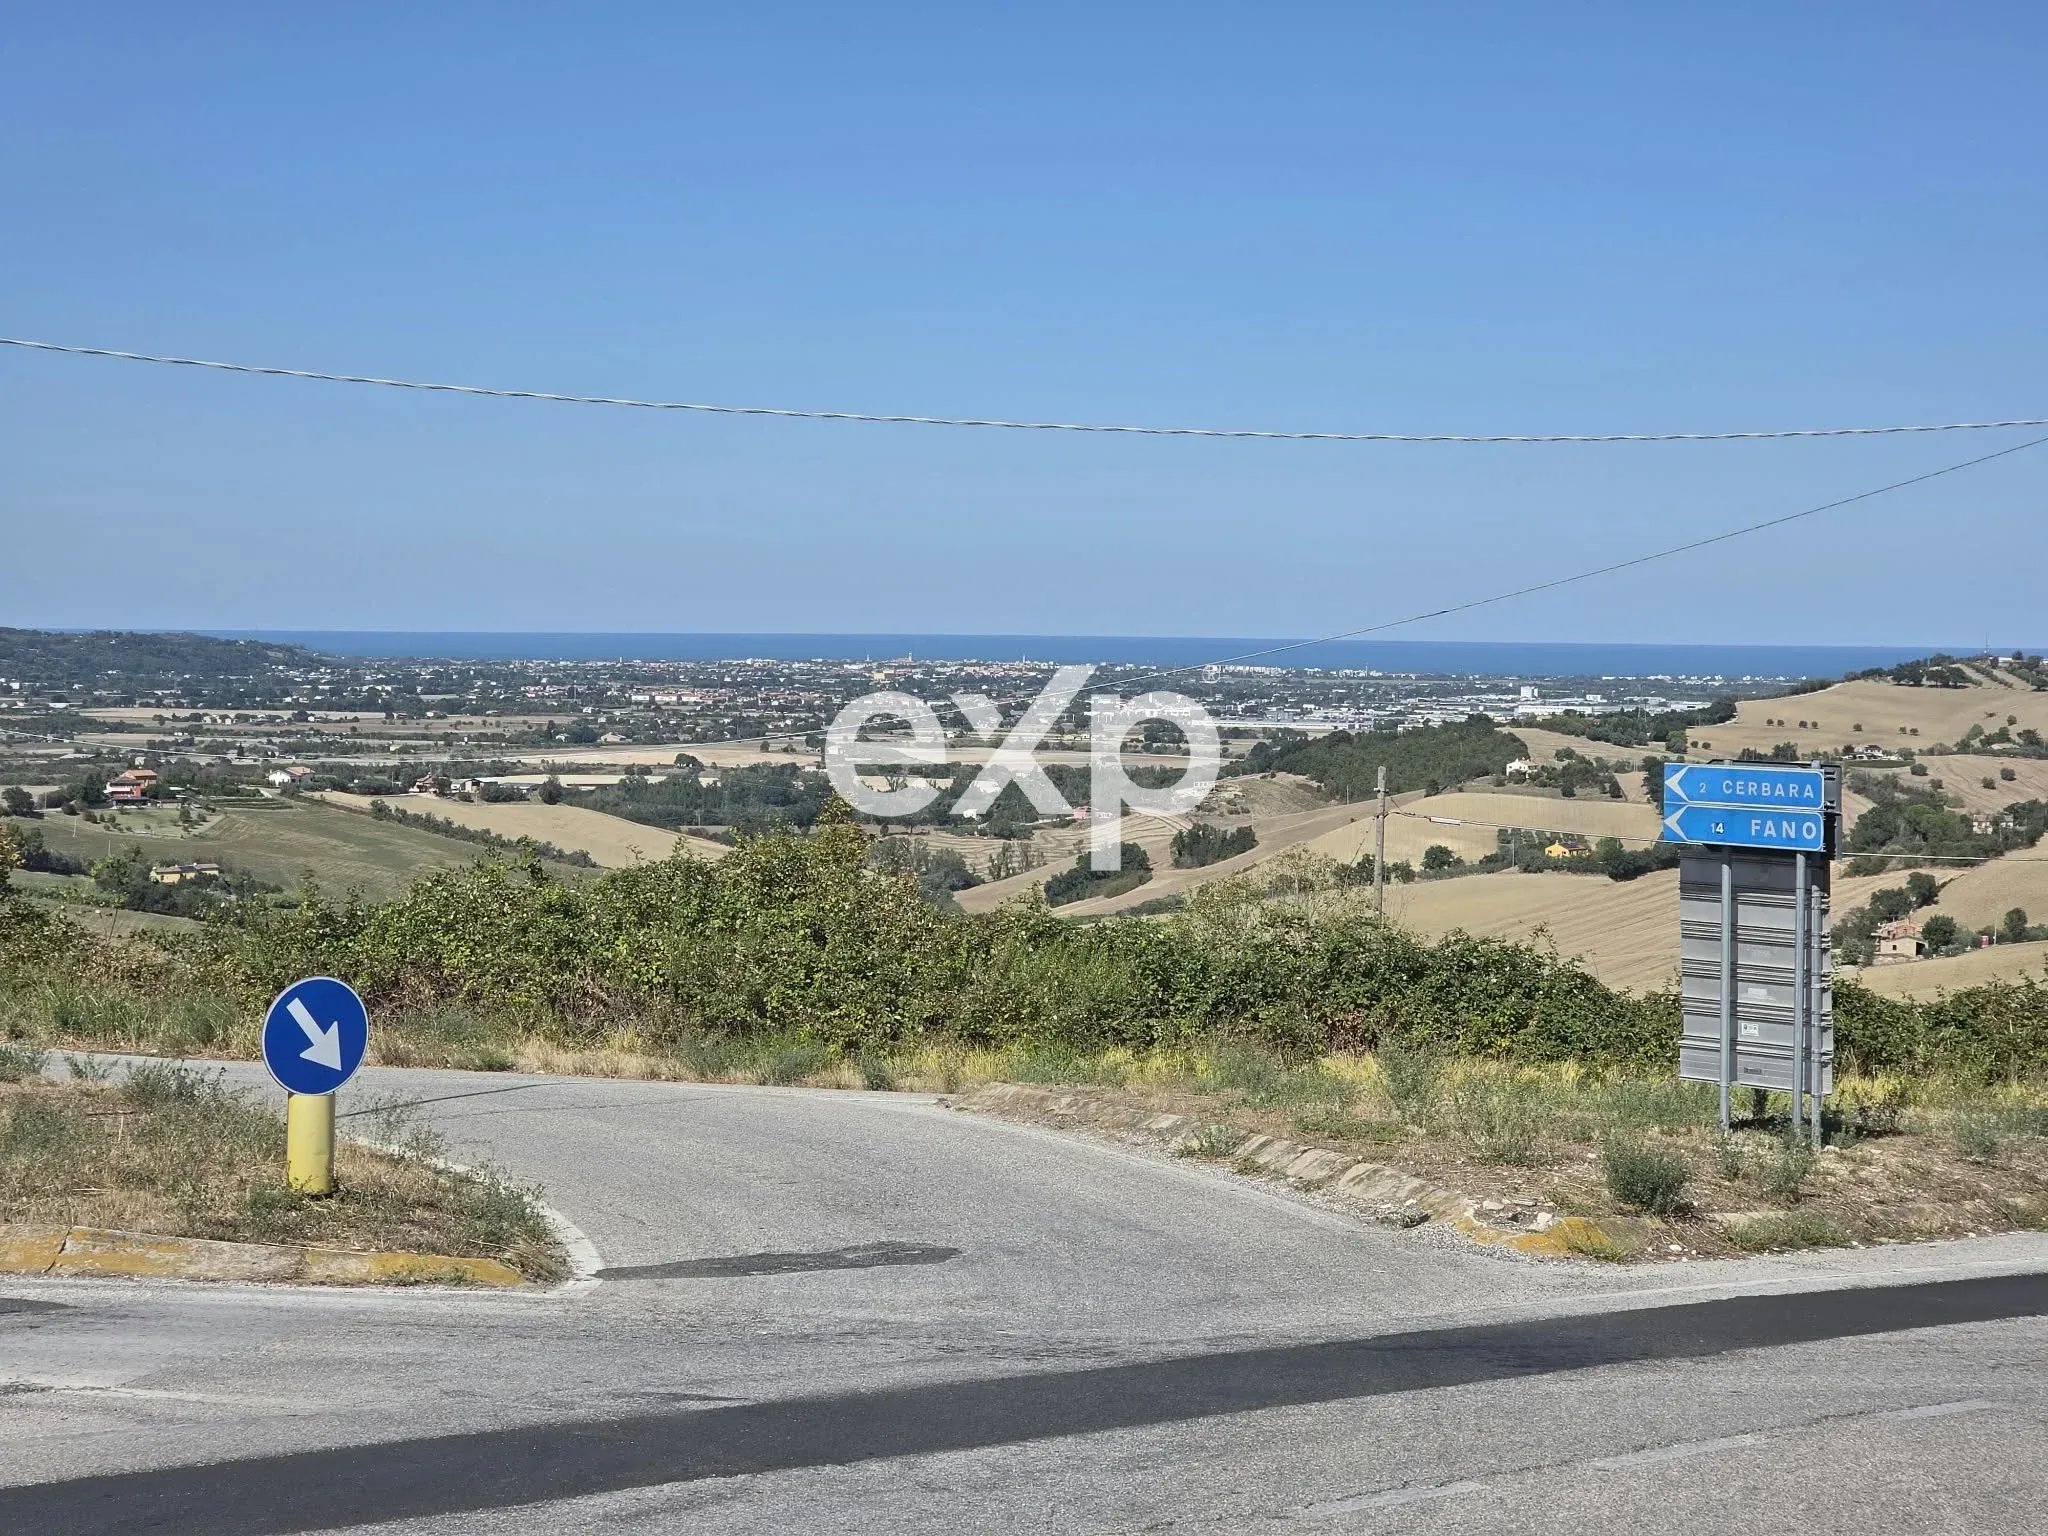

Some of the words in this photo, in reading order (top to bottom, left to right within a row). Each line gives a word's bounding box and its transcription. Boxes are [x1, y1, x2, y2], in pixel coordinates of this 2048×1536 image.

[1699, 783, 1706, 793] 2
[1722, 780, 1814, 799] CERBARA
[1711, 822, 1725, 834] 14
[1751, 819, 1817, 840] FANO
